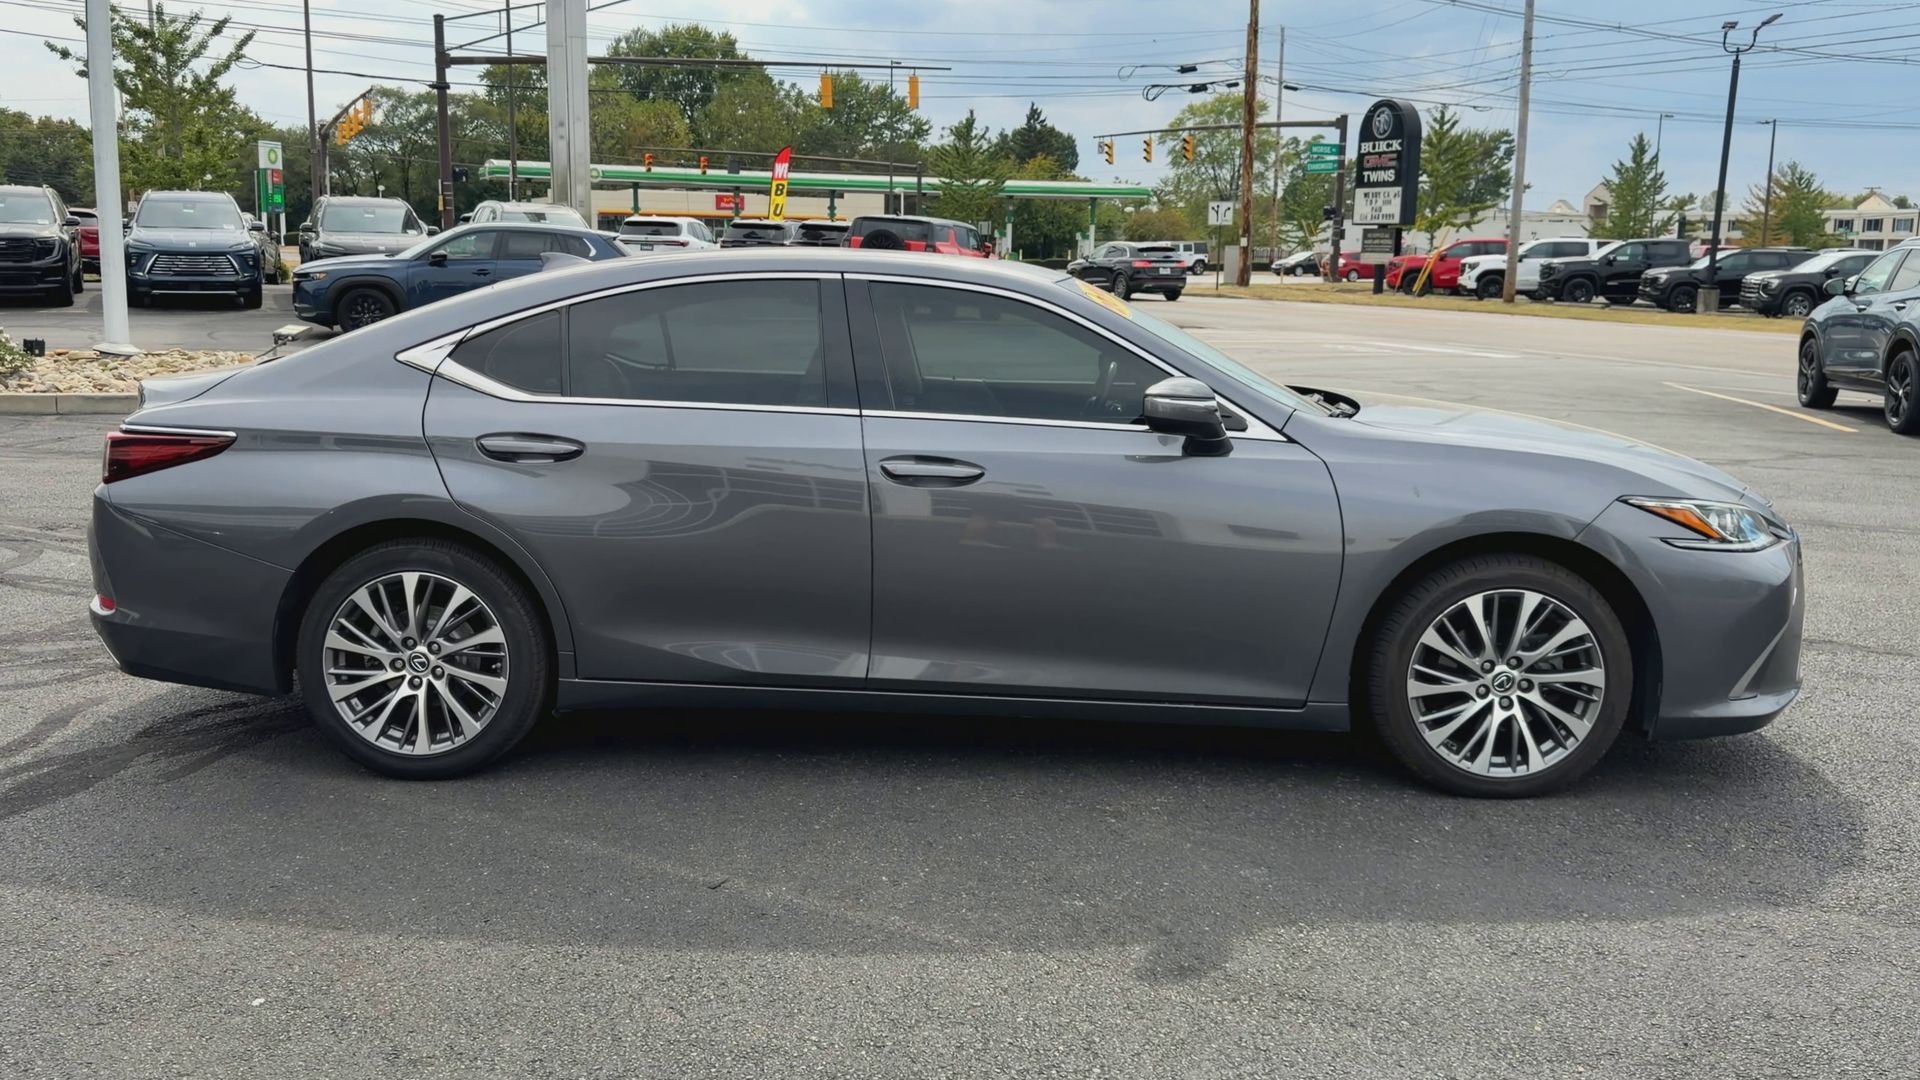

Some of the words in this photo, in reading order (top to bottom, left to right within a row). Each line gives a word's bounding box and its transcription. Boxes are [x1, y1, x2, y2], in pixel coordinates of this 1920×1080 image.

[1360, 139, 1402, 154] BUICK
[1363, 153, 1398, 168] GMC
[1362, 169, 1396, 183] TWINS
